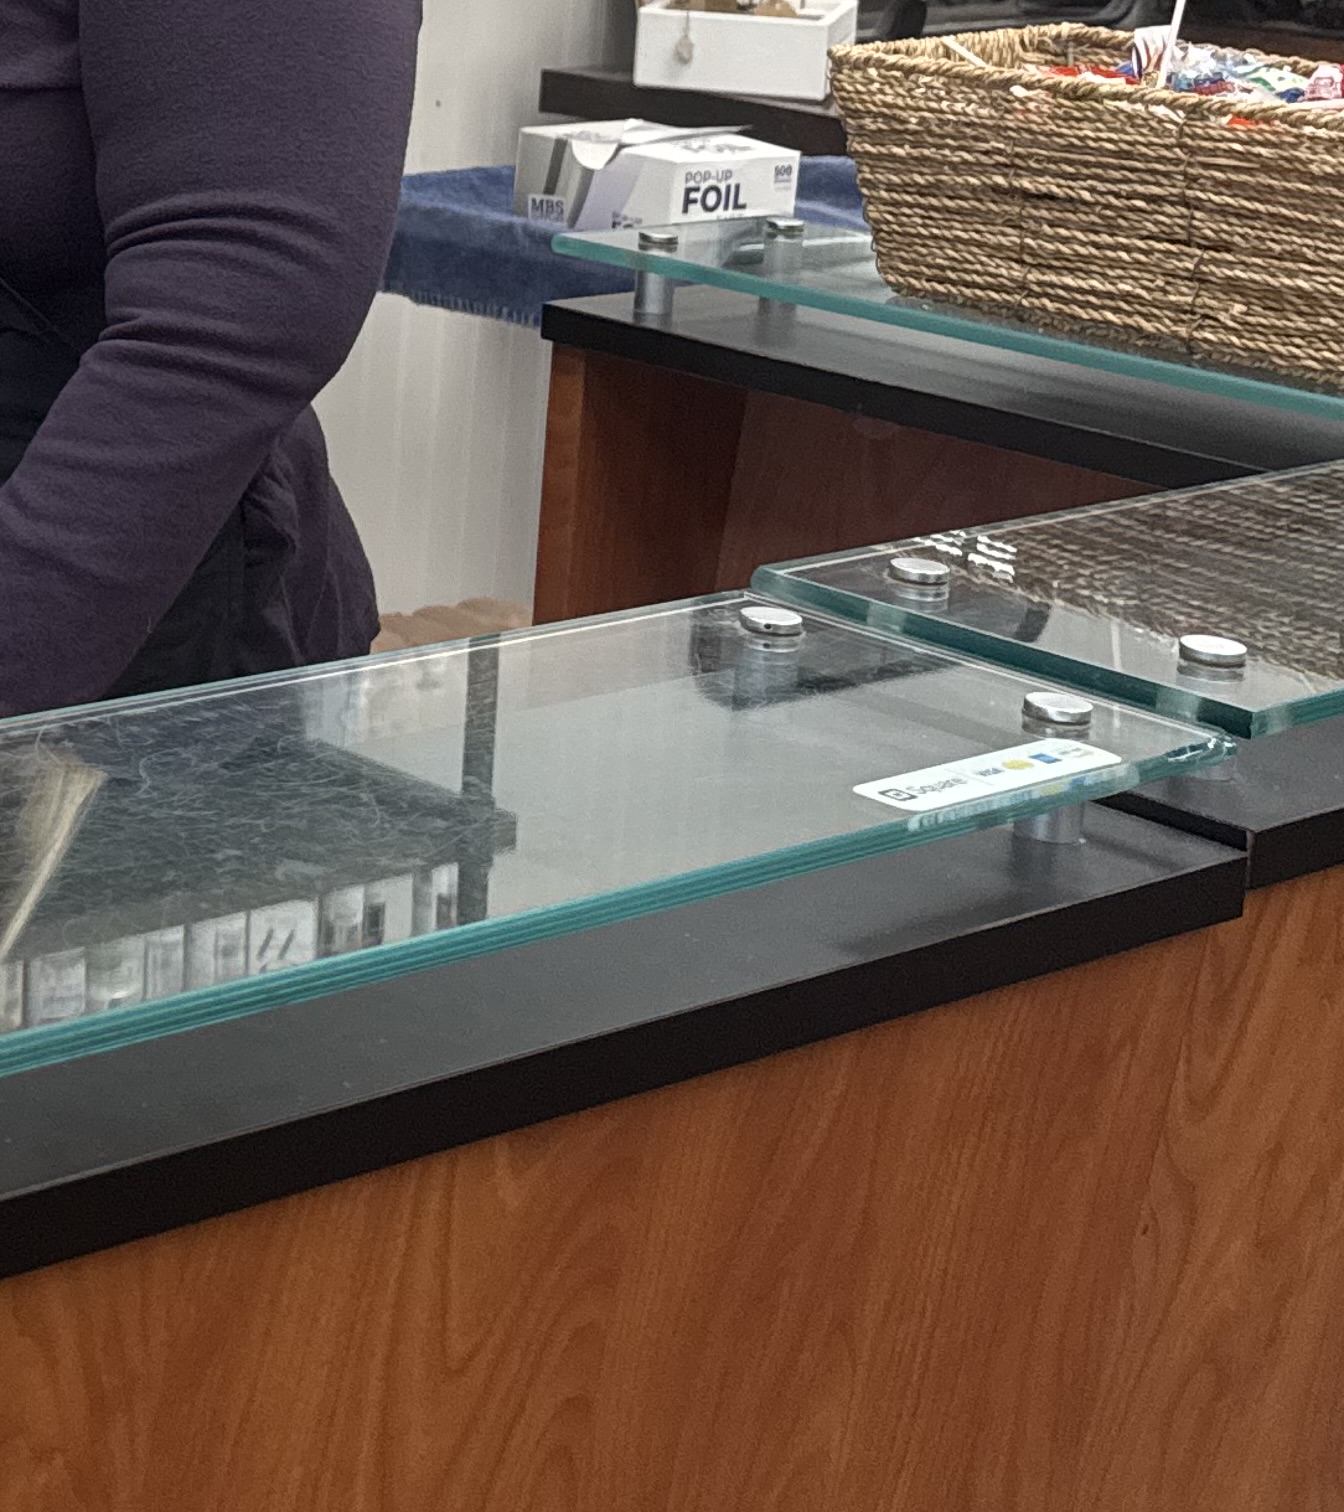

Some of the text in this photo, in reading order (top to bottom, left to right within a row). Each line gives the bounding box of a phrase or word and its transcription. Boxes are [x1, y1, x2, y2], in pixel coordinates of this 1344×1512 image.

[684, 169, 734, 185] POP-UP
[530, 196, 564, 215] MBS
[681, 183, 747, 215] FOIL
